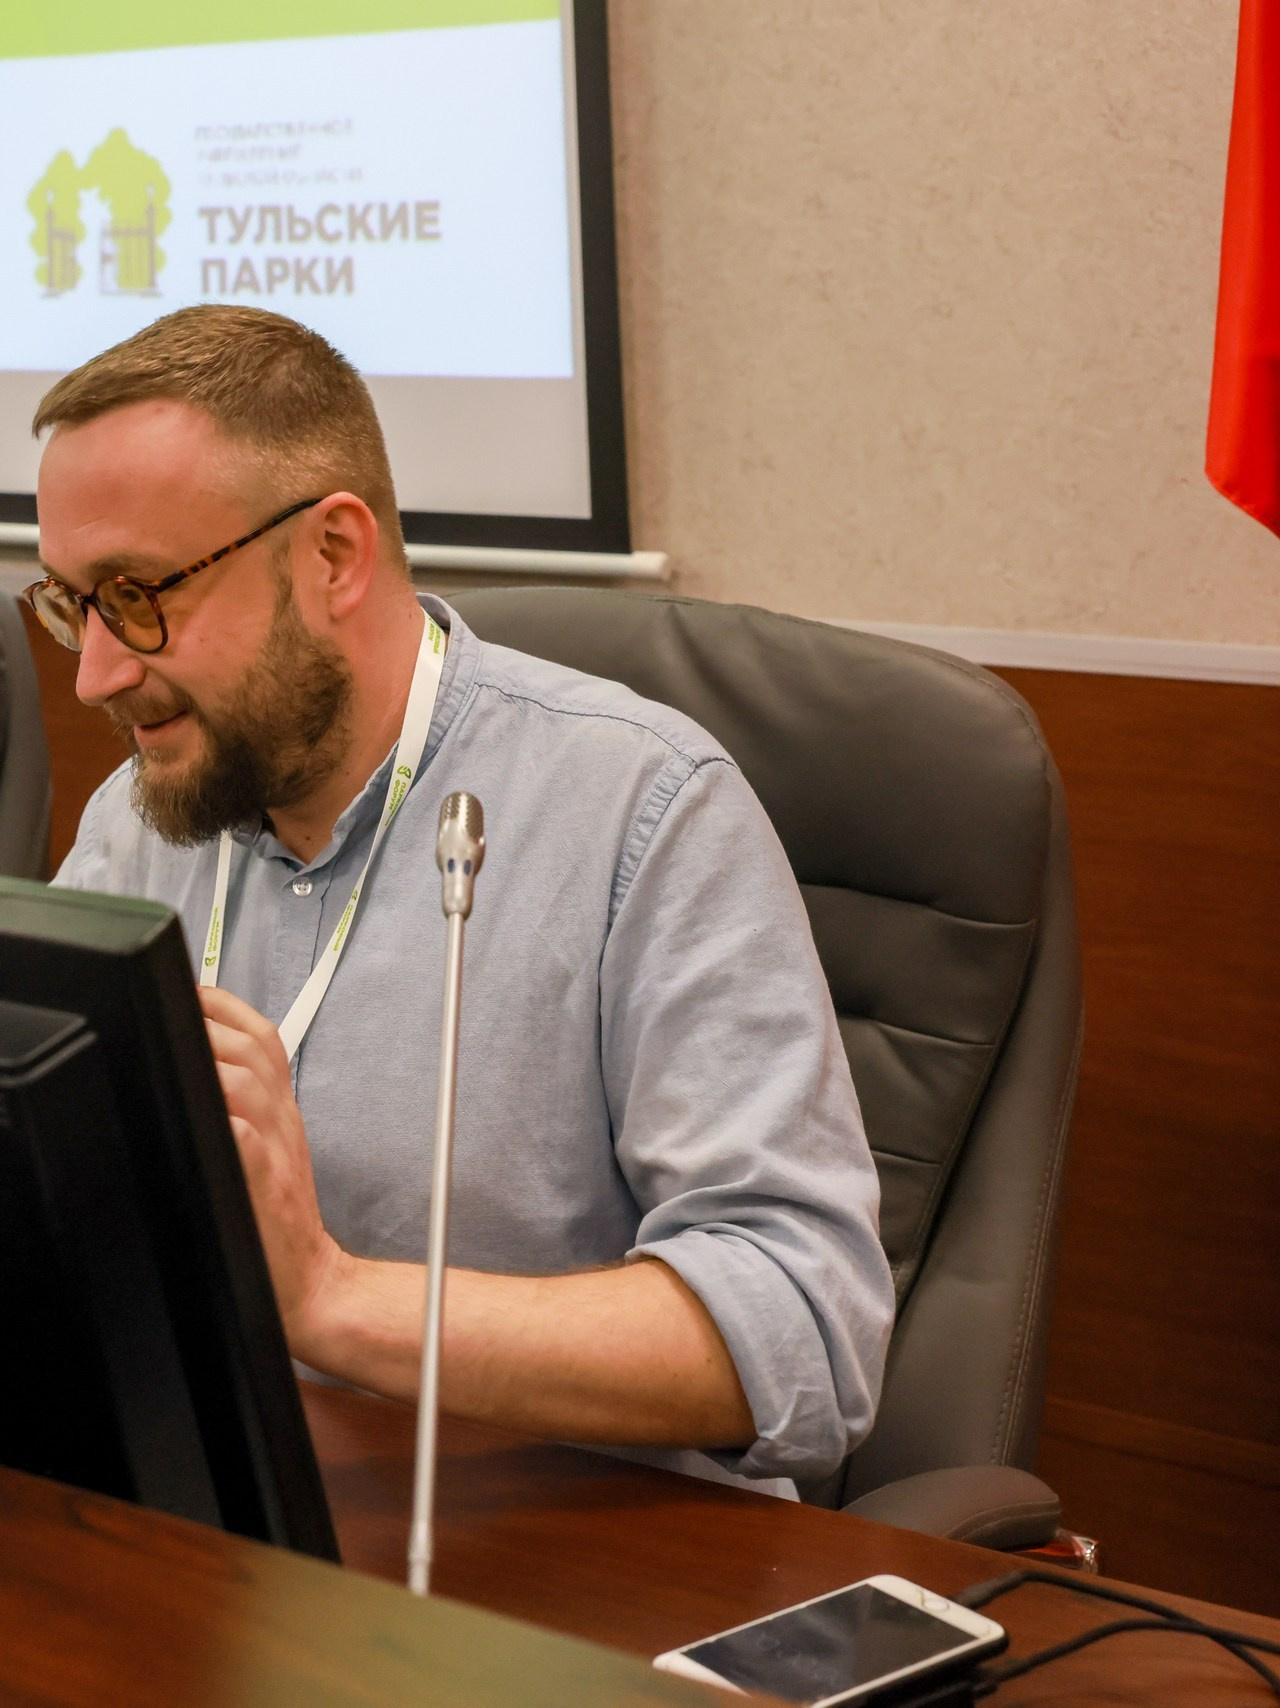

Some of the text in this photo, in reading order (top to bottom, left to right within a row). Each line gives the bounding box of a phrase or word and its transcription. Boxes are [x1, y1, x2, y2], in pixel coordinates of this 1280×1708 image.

[198, 200, 442, 245] ТУЛЬСКИЕ
[201, 256, 355, 296] ПАРКИ
[388, 779, 401, 810] ФОРУМ
